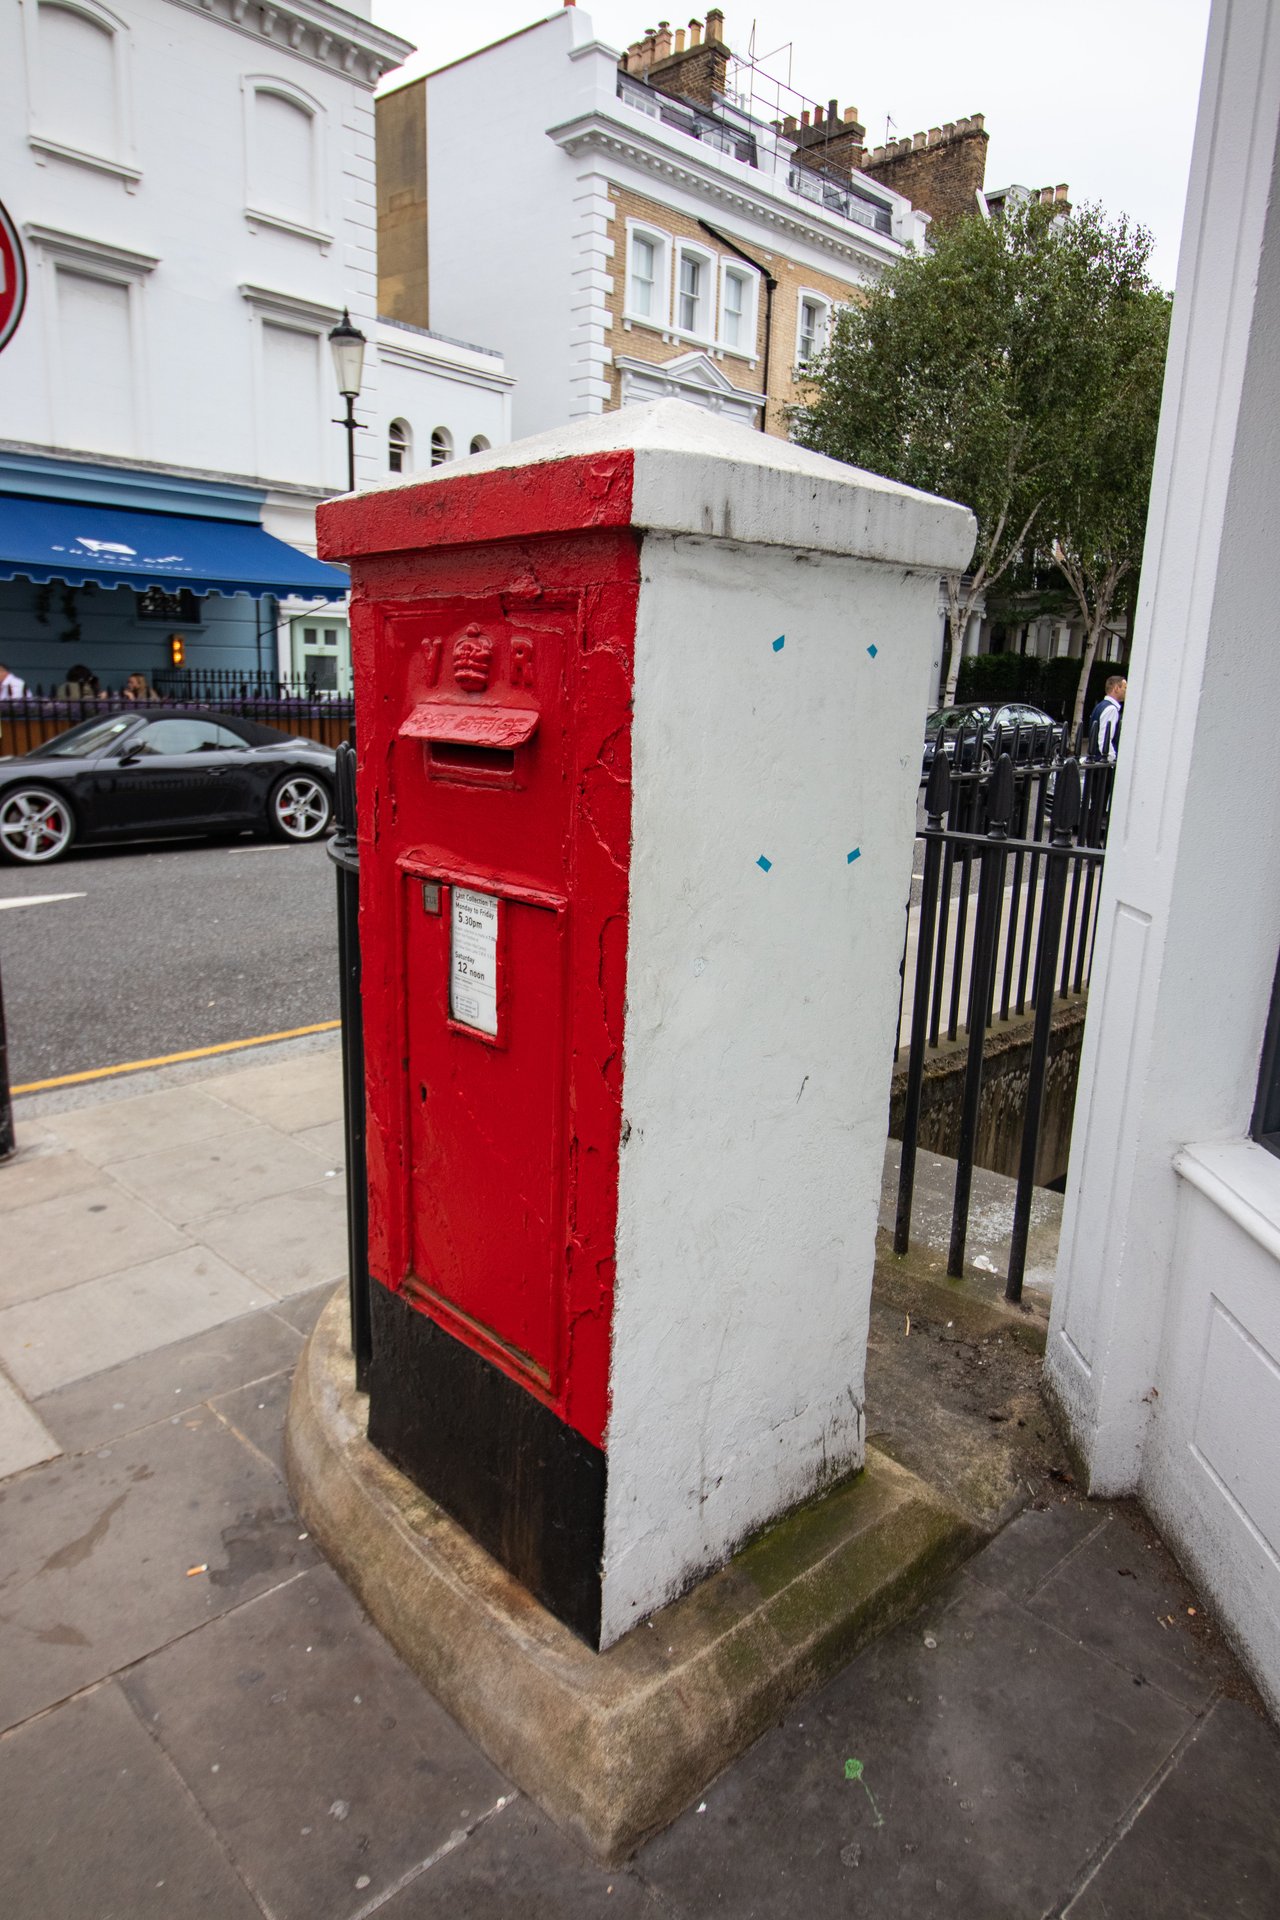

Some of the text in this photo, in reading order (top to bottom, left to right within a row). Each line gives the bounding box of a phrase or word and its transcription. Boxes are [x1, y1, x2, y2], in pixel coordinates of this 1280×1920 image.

[510, 636, 533, 688] R
[455, 891, 466, 901] Last
[466, 894, 489, 907] Collection
[455, 902, 473, 914] Monday
[479, 908, 495, 920] Friday
[458, 911, 483, 929] 5.30pm
[455, 951, 475, 965] Saturday
[457, 961, 468, 975] 12
[469, 969, 485, 981] noon
